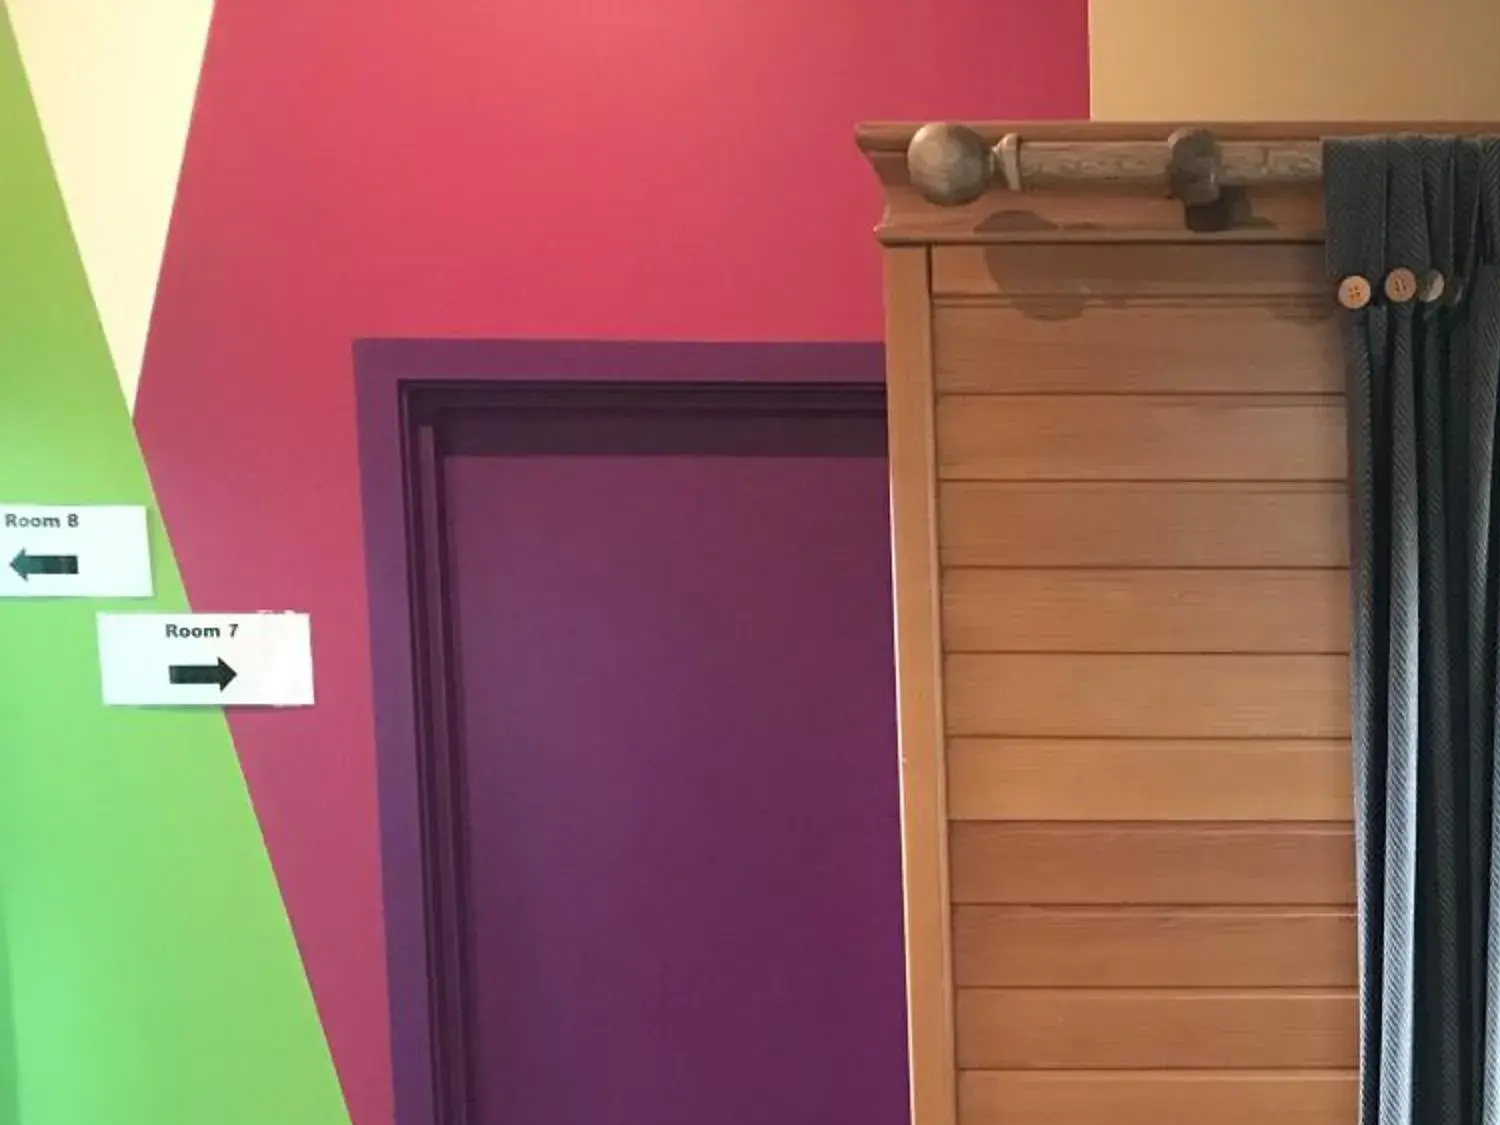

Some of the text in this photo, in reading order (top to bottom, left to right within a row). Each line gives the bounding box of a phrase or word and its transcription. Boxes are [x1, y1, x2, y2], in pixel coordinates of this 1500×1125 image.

[5, 513, 79, 528] Room 8
[165, 623, 239, 639] Room 7
